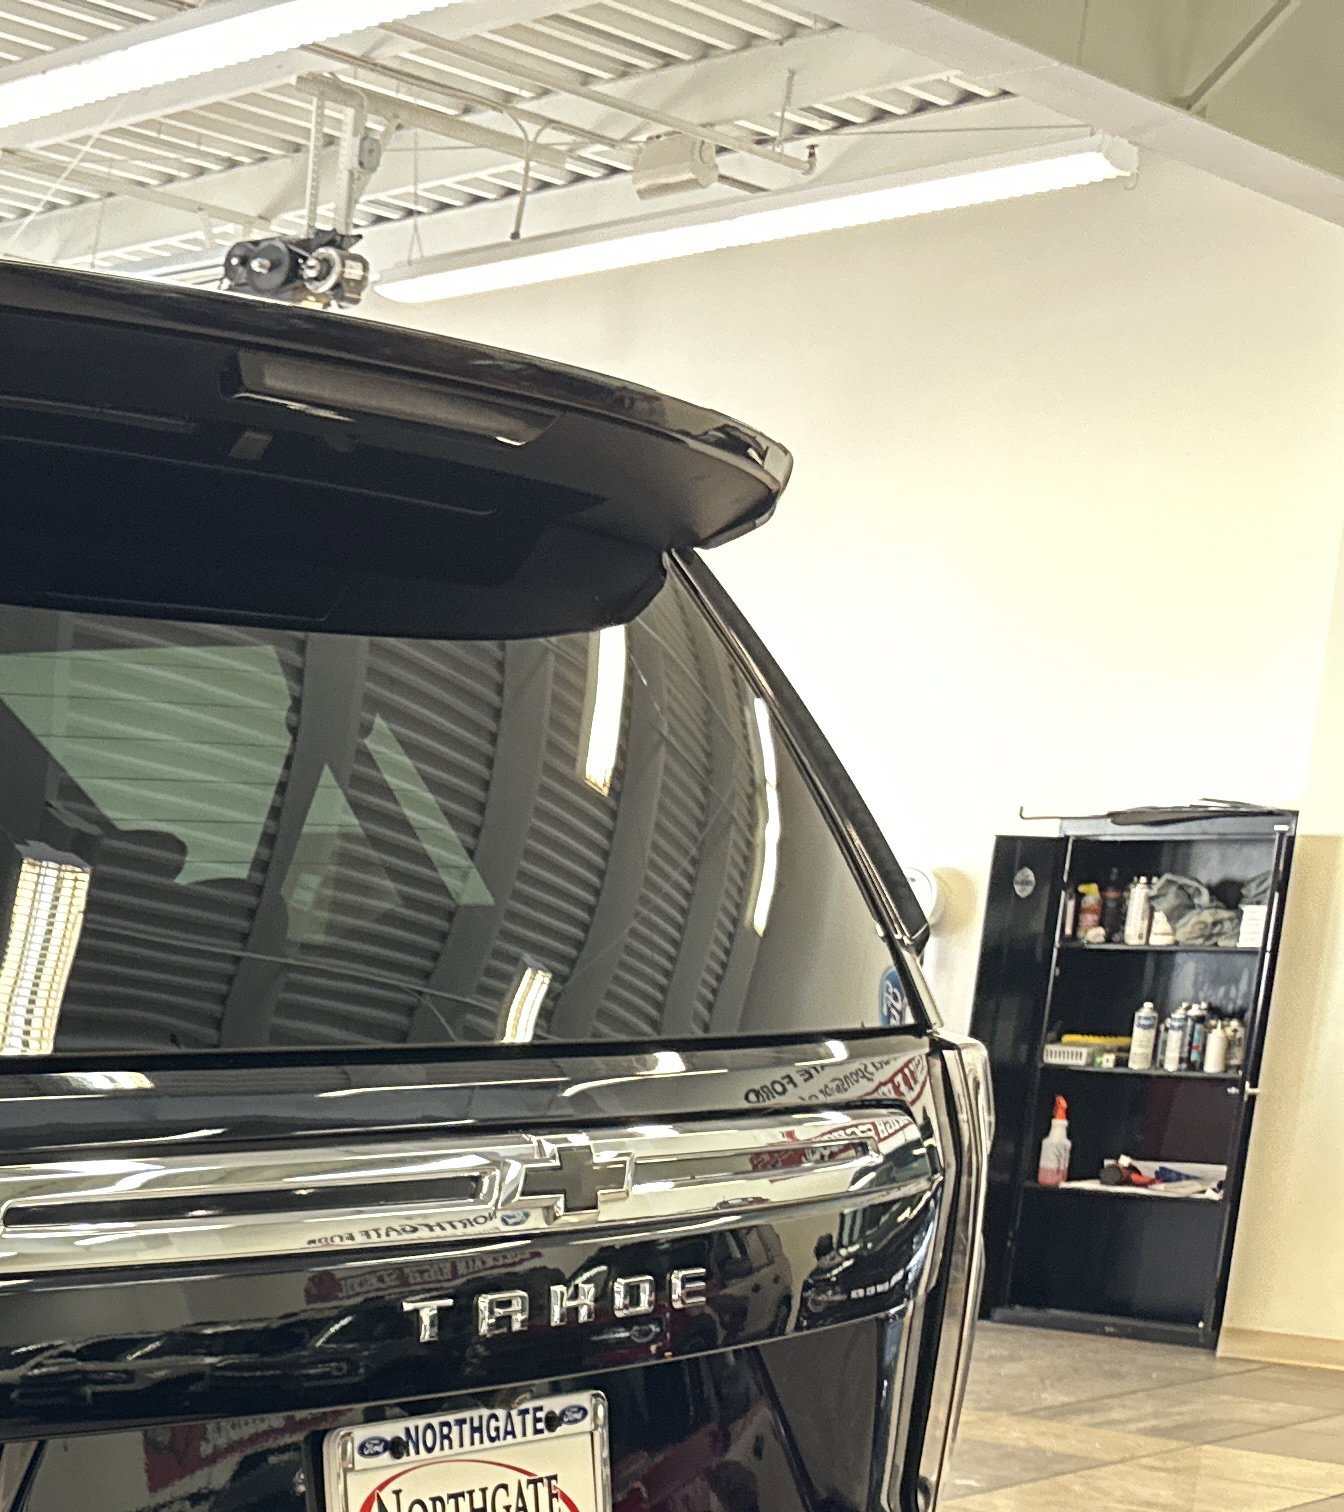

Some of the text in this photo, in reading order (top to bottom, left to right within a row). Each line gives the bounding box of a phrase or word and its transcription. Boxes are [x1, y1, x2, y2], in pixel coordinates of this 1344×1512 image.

[402, 1266, 707, 1343] TAHOE
[361, 1438, 387, 1456] Ford
[404, 1405, 545, 1457] NORTHGATE
